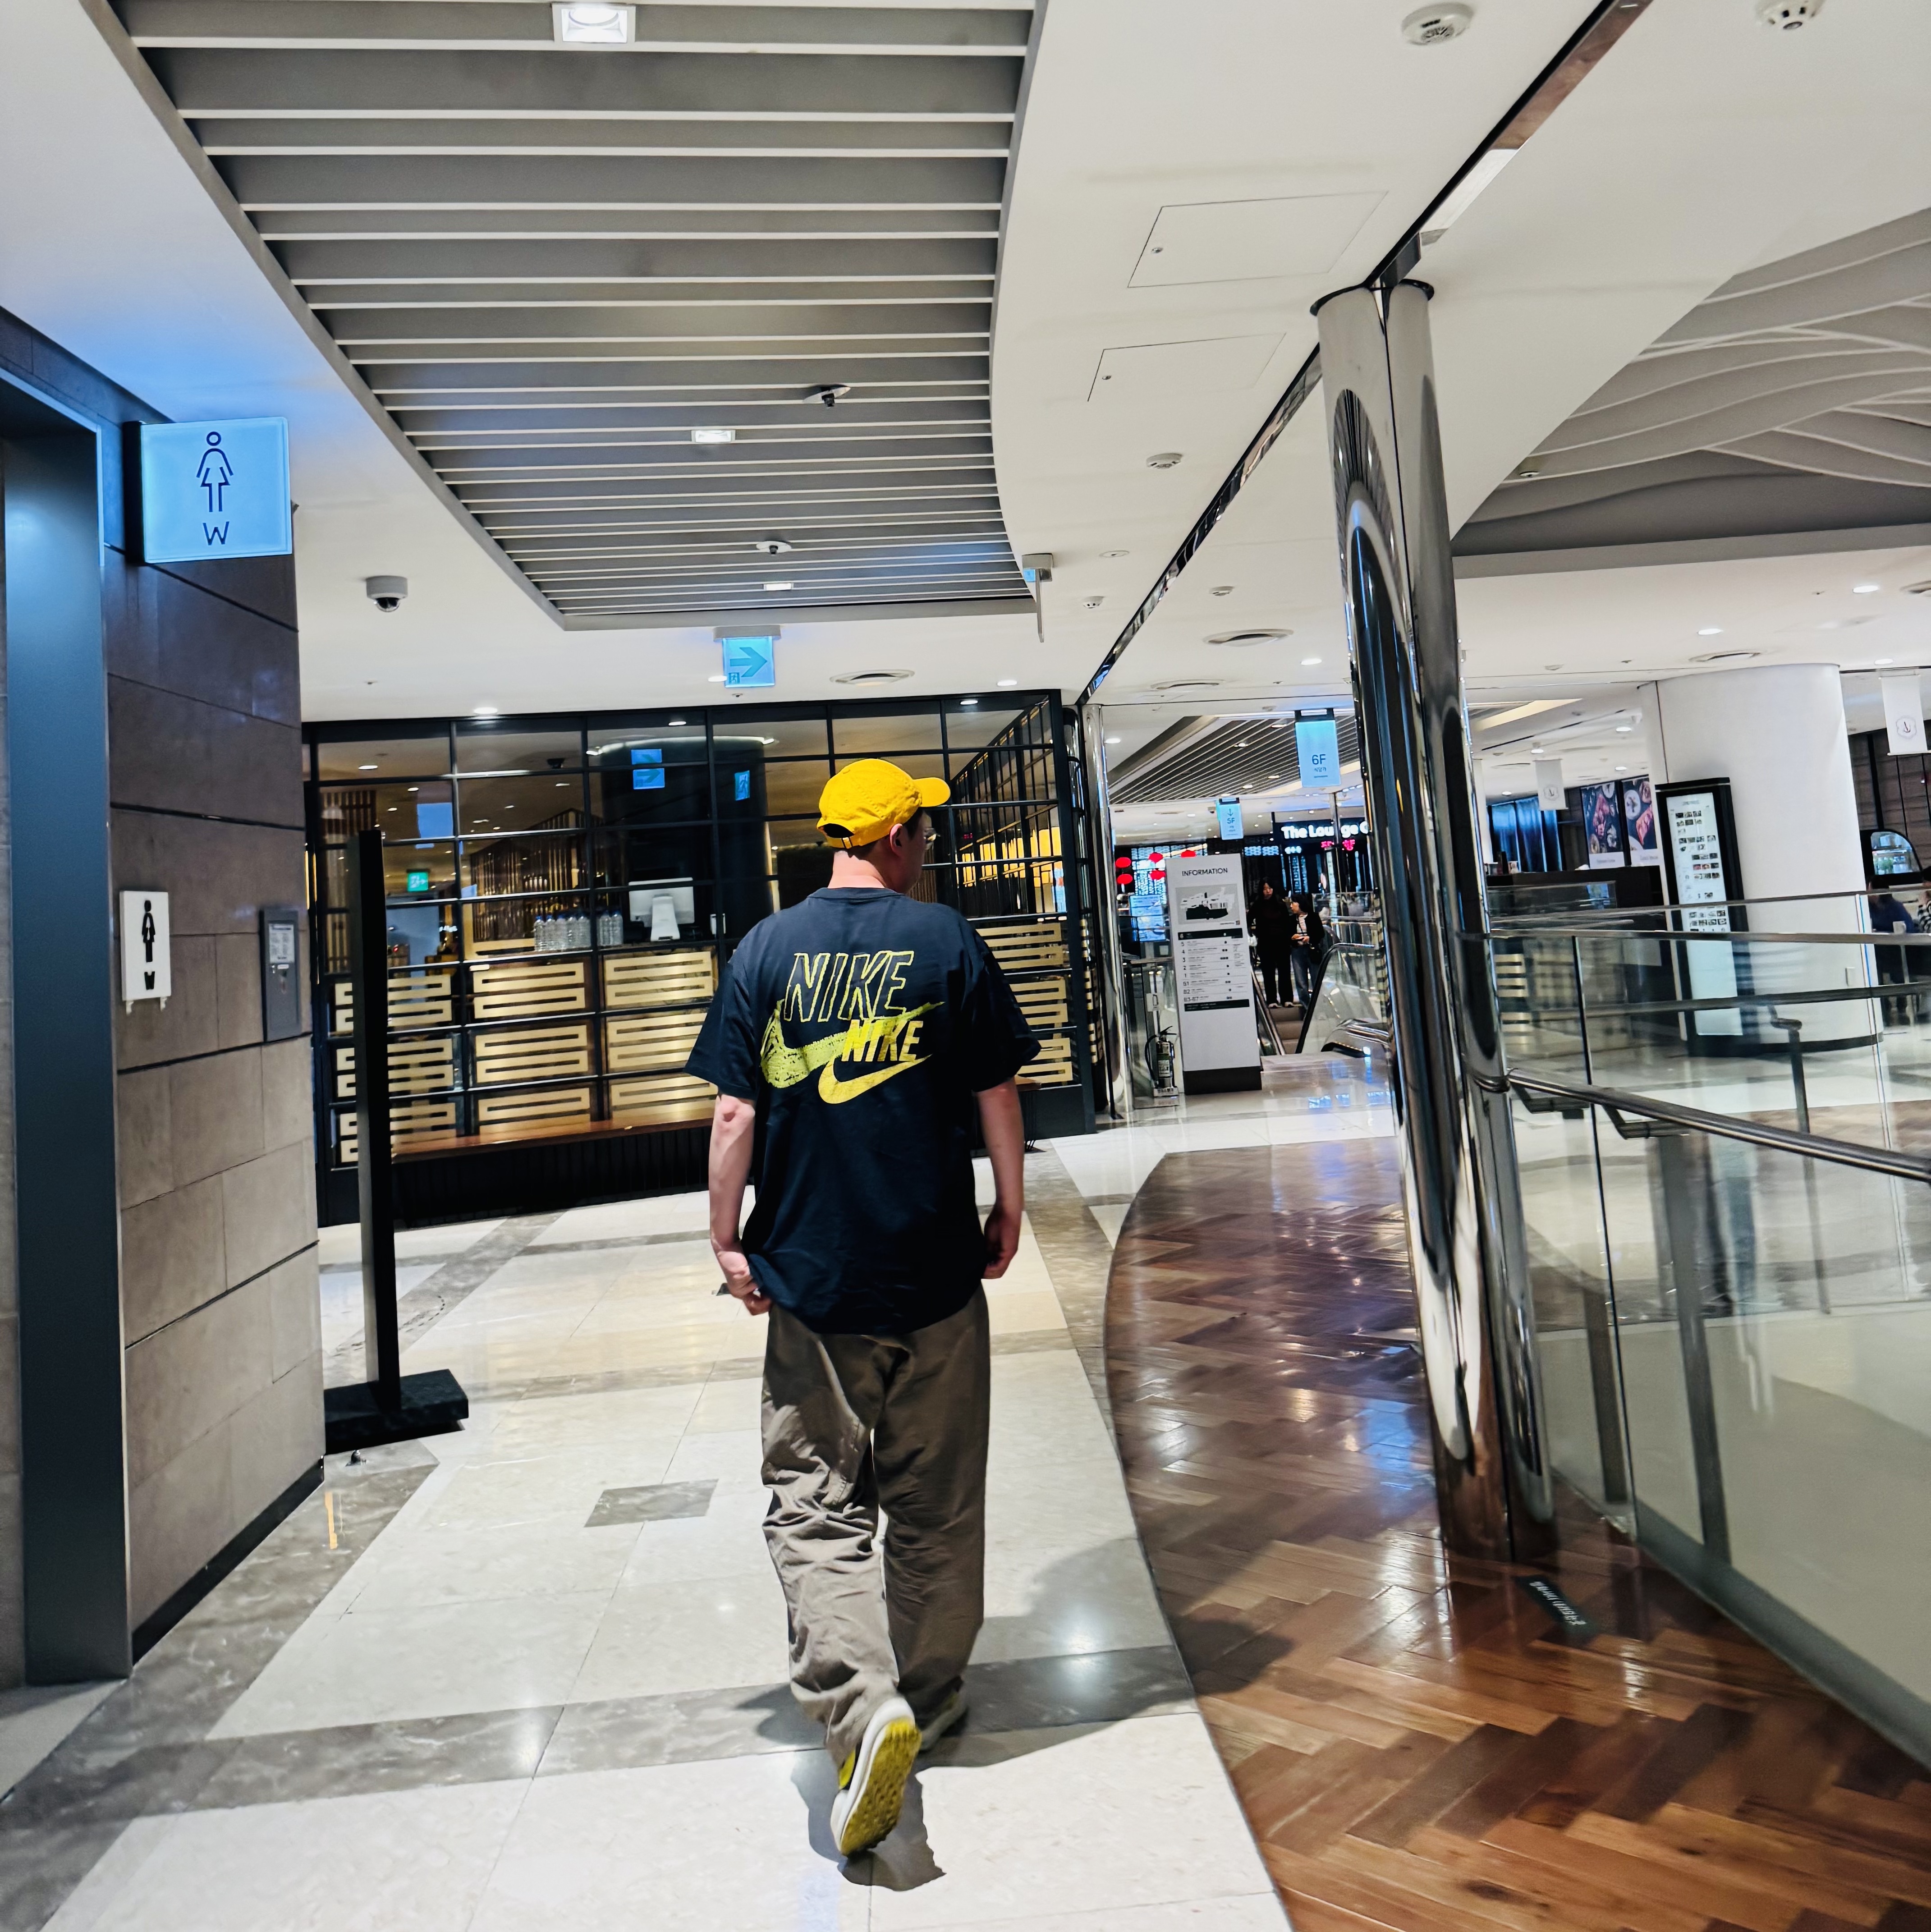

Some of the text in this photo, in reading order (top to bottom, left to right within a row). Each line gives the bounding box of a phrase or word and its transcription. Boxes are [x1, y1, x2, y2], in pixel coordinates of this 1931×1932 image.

[203, 521, 229, 546] W
[1312, 754, 1326, 765] 6F
[1281, 825, 1307, 839] The
[1308, 822, 1358, 838] Louge
[1182, 867, 1228, 876] INFORMATION
[784, 950, 914, 1022] NIKE
[841, 1019, 923, 1061] NIKE
